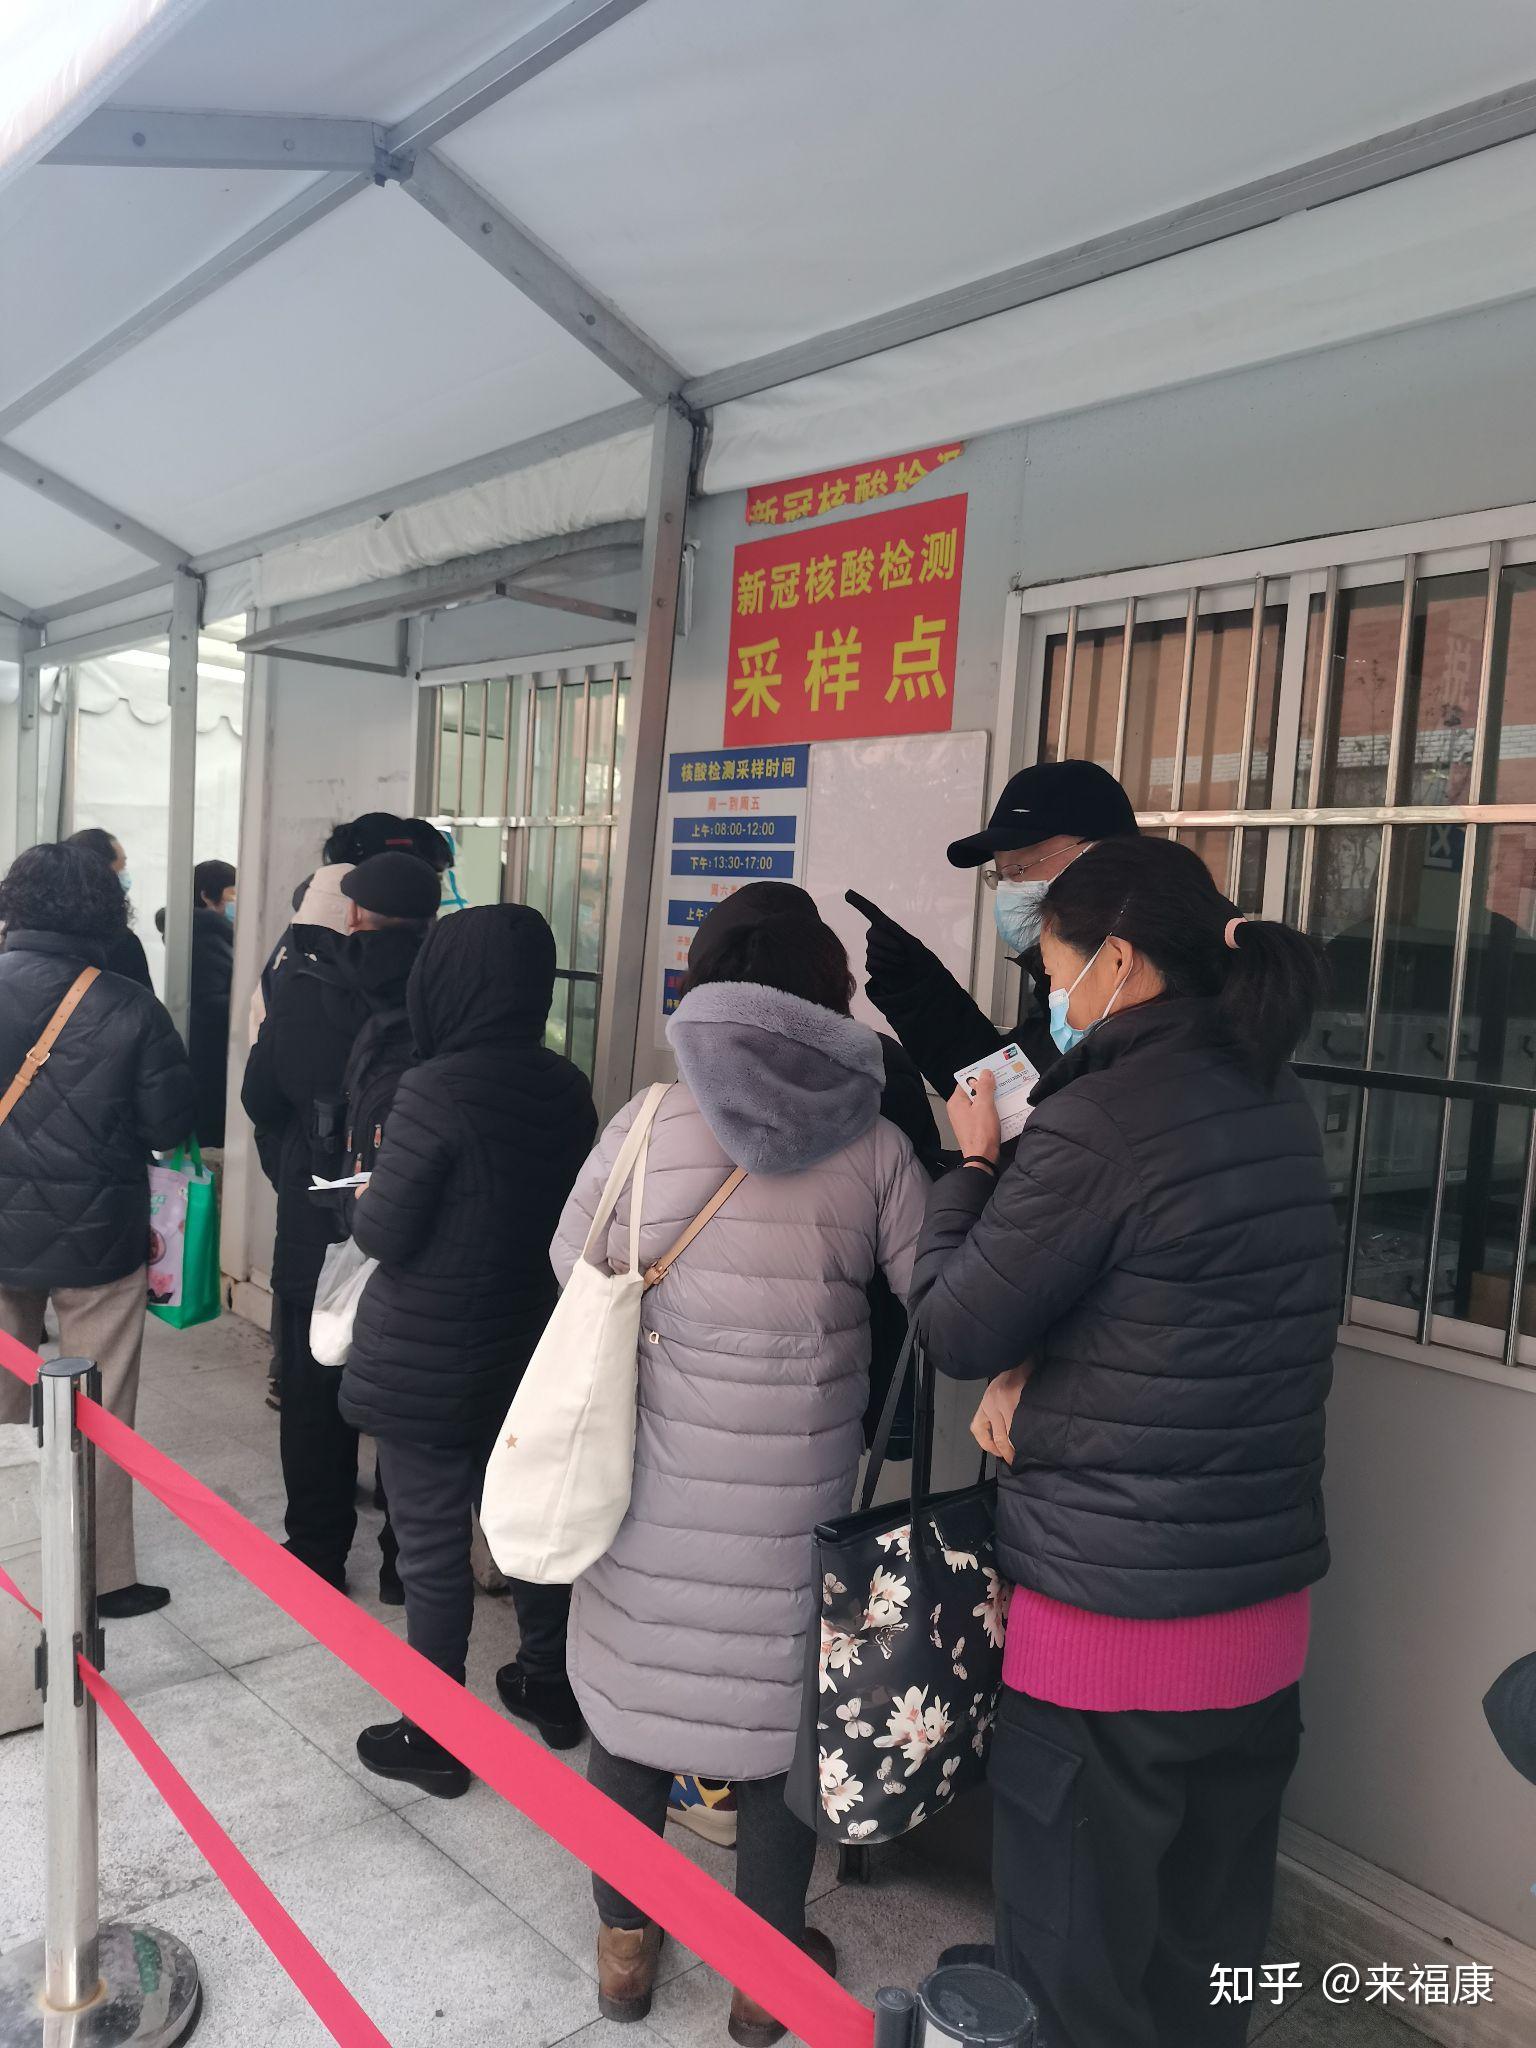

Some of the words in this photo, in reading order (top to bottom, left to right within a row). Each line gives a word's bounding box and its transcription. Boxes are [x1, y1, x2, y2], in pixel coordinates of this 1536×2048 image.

[736, 528, 957, 616] 新冠核酸检测
[731, 614, 947, 718] 采样点
[681, 757, 795, 782] 核酸检测采样时间
[708, 796, 761, 811] 周一到周五
